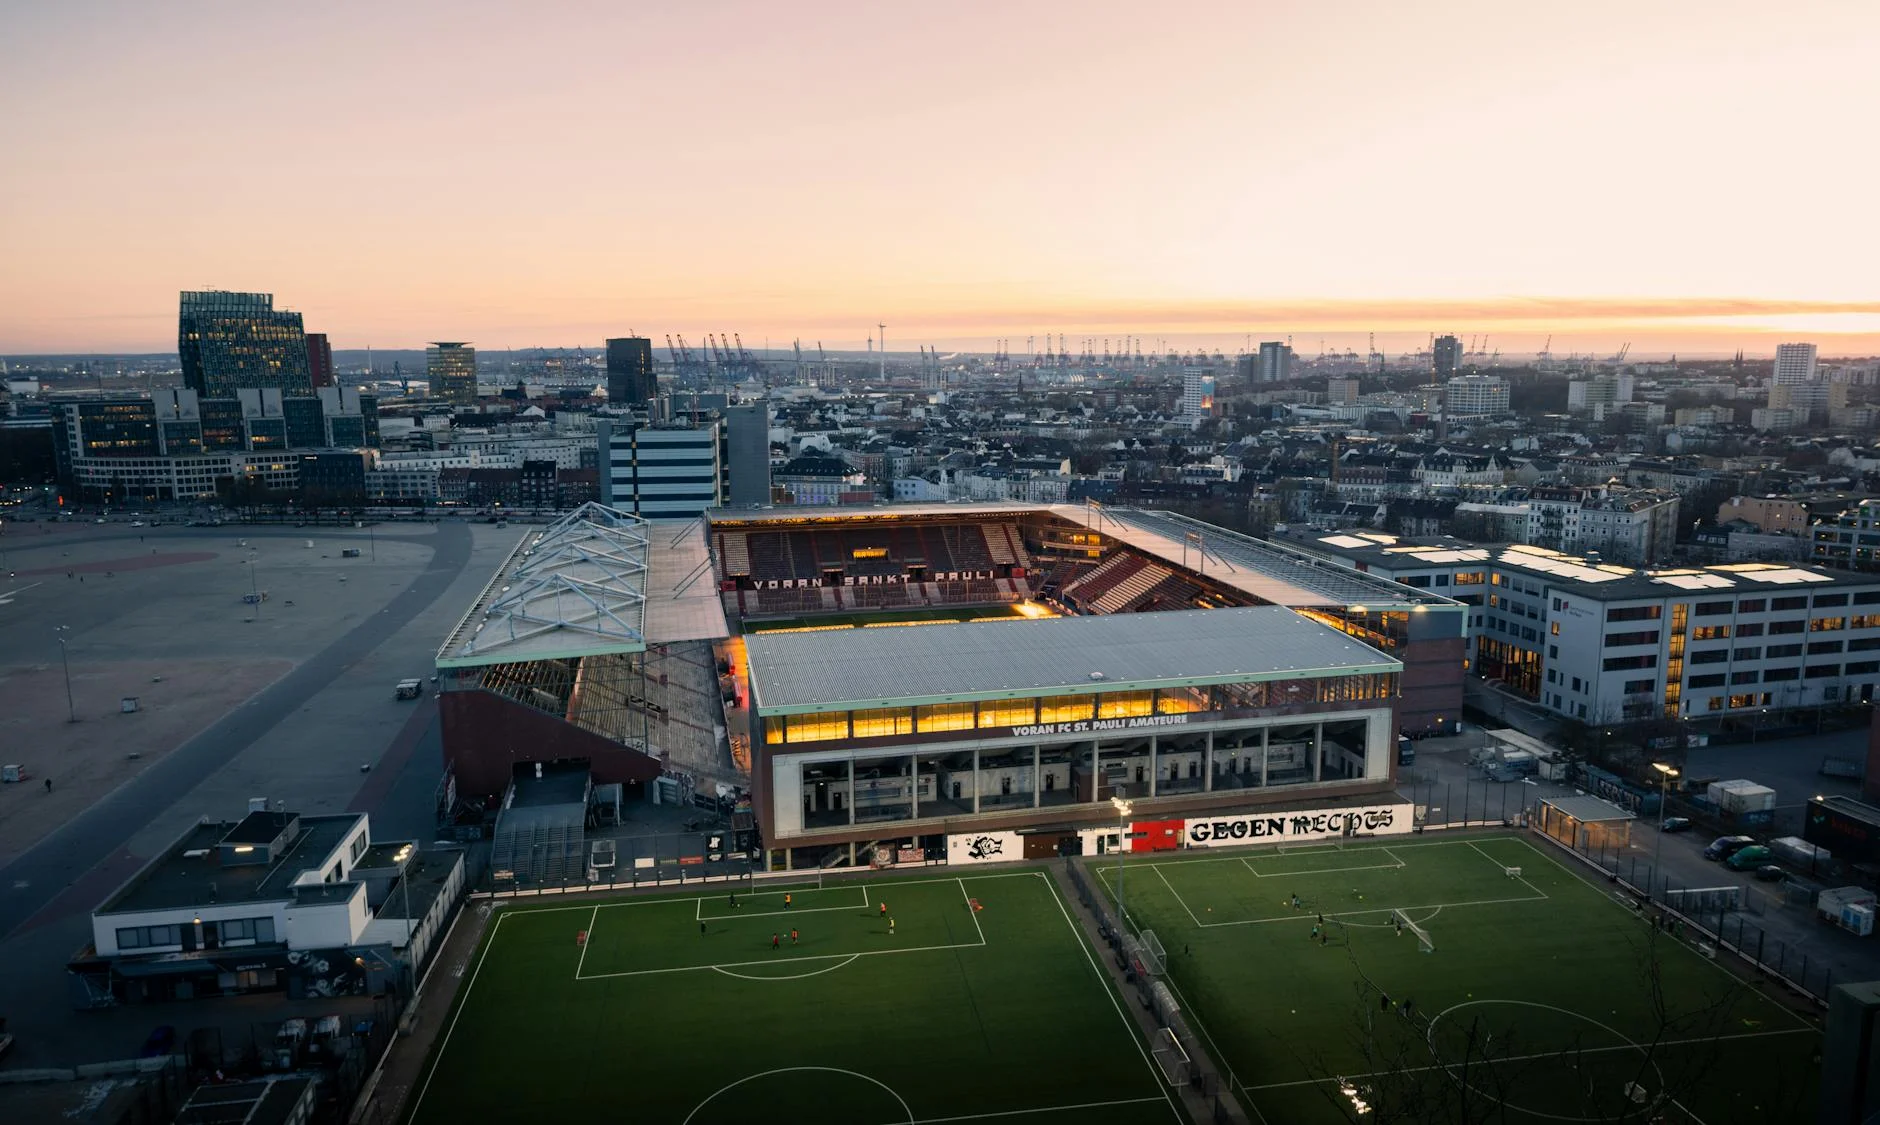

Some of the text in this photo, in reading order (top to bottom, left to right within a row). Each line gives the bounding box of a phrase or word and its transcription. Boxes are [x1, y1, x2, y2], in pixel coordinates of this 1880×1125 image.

[753, 570, 994, 590] VORAN SANKT PAULI
[1012, 715, 1188, 737] VORAN FC ST. PAULI AMATEURE
[1190, 817, 1286, 841] GEGEN
